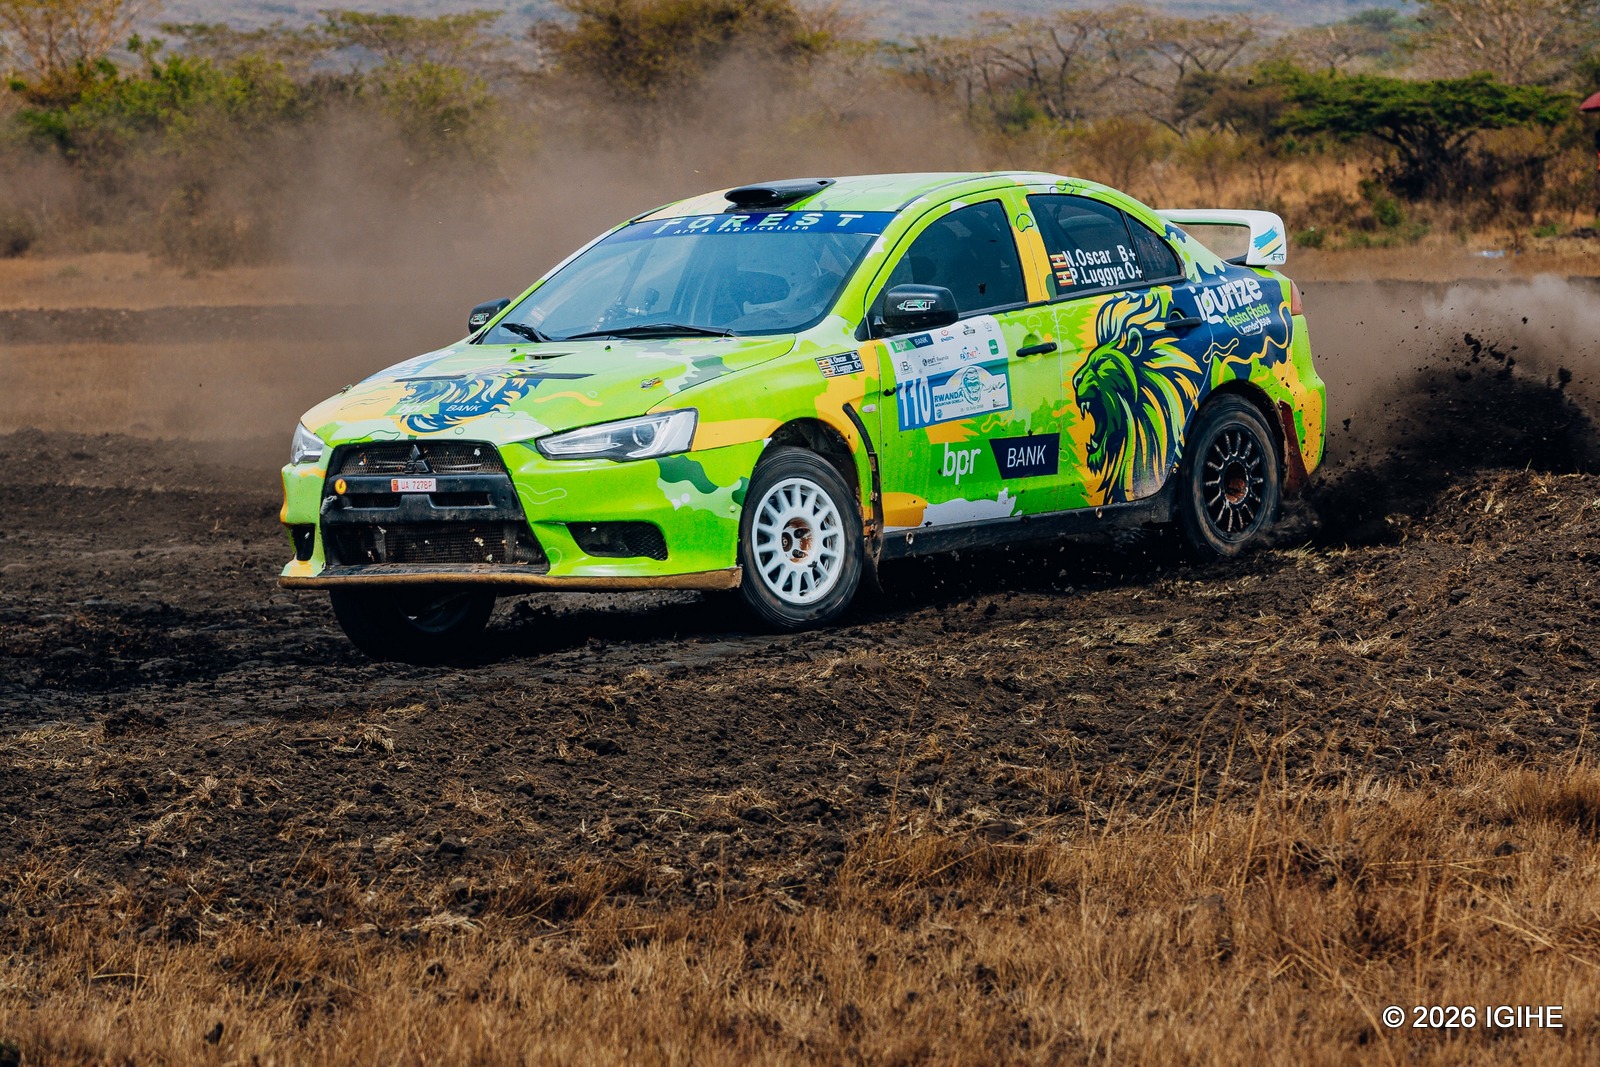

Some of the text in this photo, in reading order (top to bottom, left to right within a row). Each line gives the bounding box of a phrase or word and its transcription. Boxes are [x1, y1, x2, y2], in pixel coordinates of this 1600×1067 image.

[652, 212, 864, 235] FOREST
[716, 225, 809, 233] Fabrication
[1062, 244, 1136, 268] N.Oscar B+
[1069, 261, 1143, 287] P.Luggya O+
[913, 336, 929, 346] BANK
[446, 404, 483, 412] BANK
[900, 376, 932, 427] 110
[934, 391, 964, 403] RWANDA
[942, 441, 1047, 486] bpr BANK
